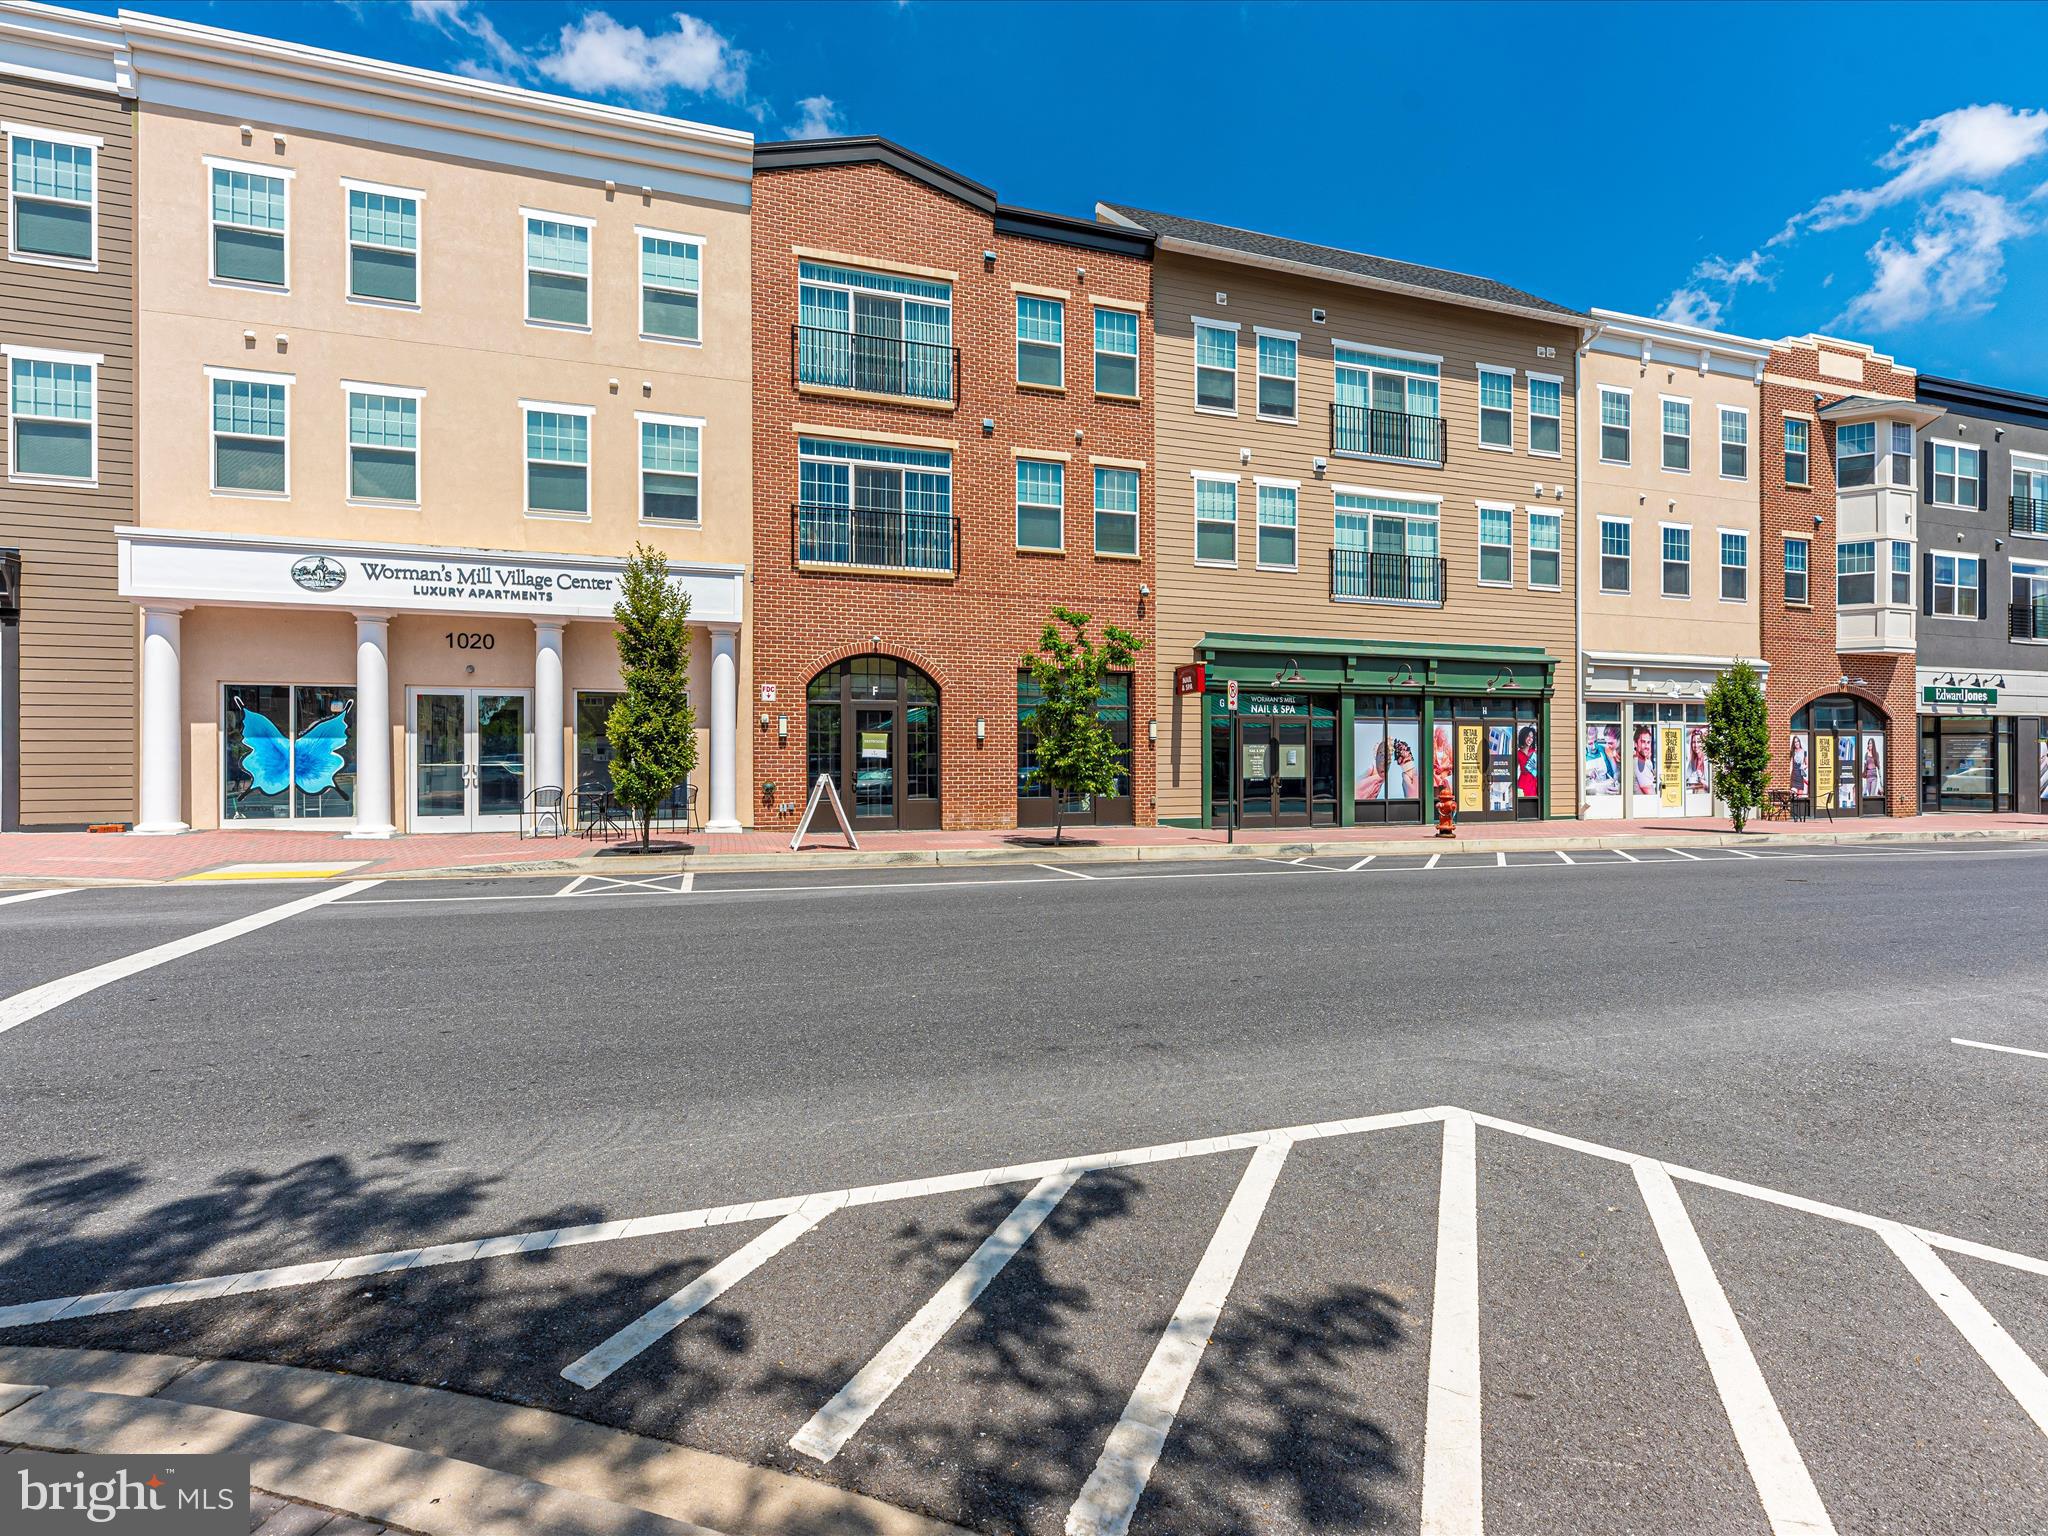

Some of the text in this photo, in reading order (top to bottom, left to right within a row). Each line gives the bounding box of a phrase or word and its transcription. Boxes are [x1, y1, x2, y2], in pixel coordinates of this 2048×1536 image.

[361, 562, 612, 591] Worman's Mill Village Center
[413, 585, 553, 602] LUXURY APARTMENTS
[445, 632, 495, 650] 1020
[872, 686, 879, 696] F
[1219, 699, 1225, 707] G
[1251, 705, 1296, 714] NAIL & SPA
